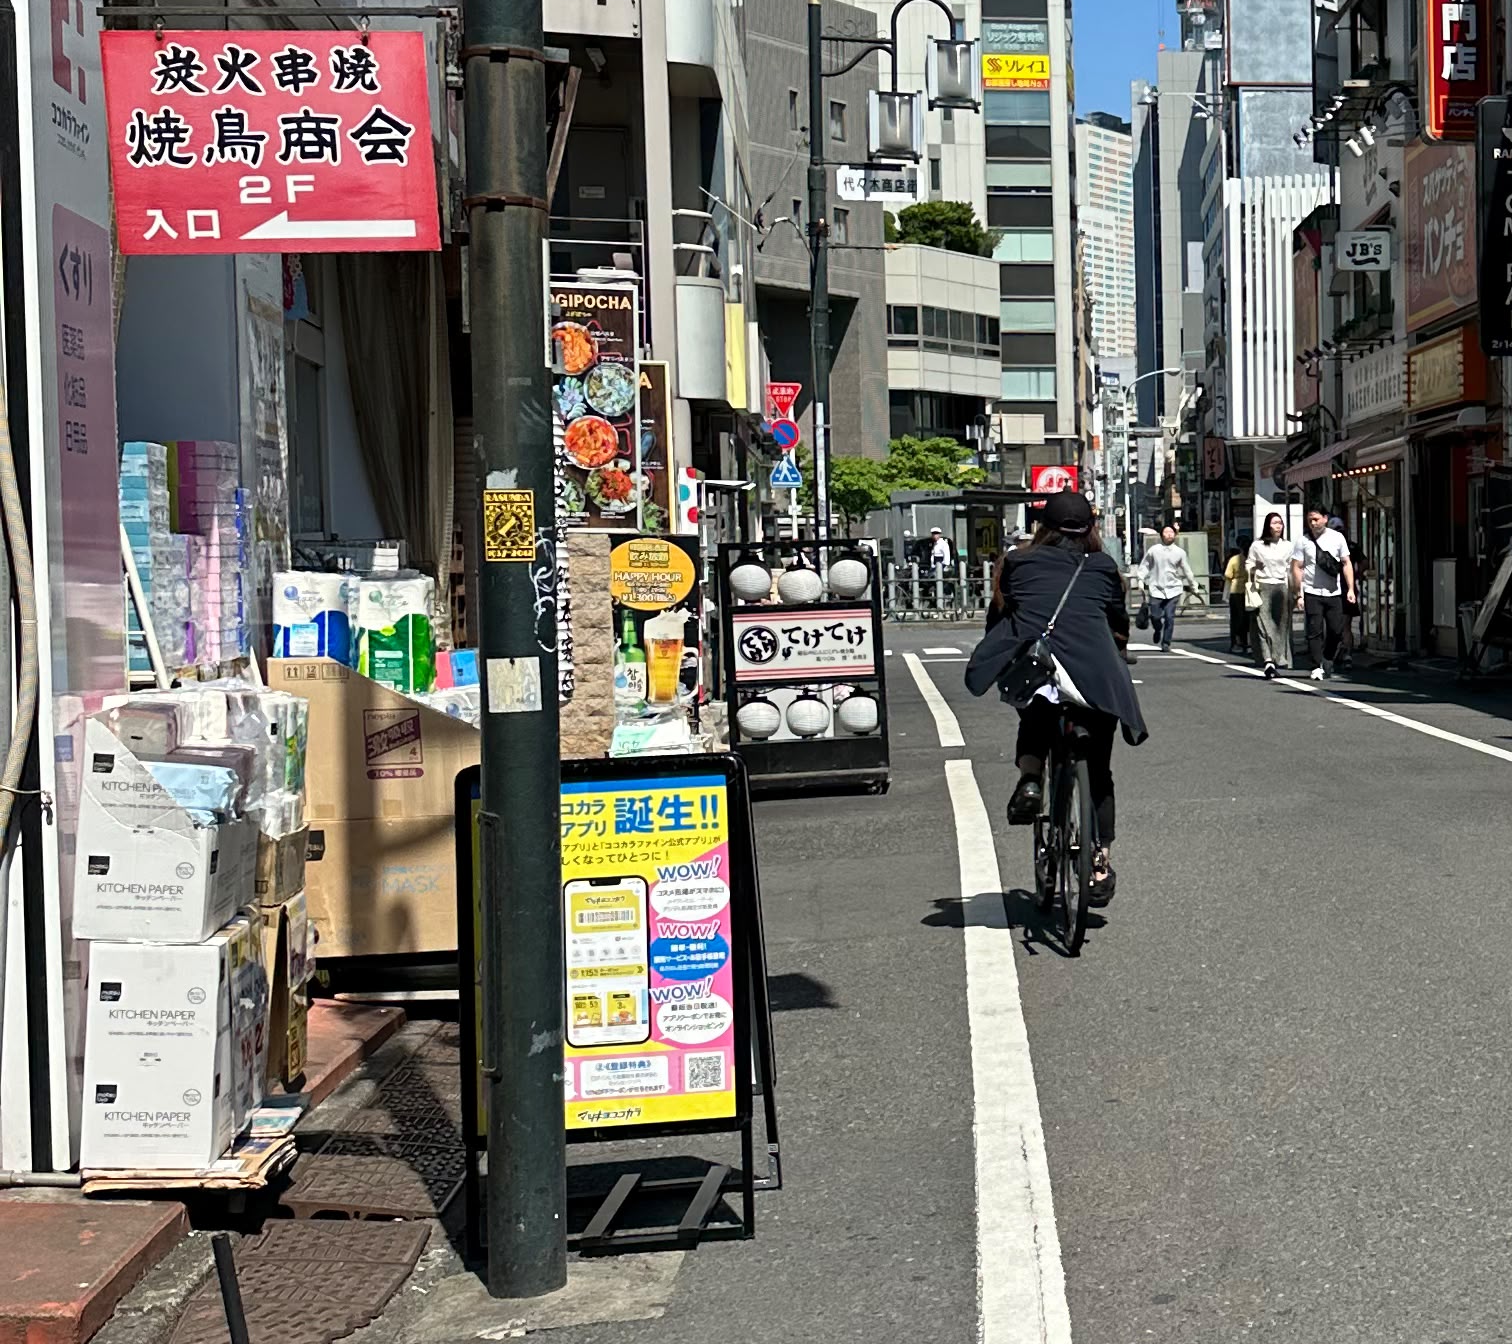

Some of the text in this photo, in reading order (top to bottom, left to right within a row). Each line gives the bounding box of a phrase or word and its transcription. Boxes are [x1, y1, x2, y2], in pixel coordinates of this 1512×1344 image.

[154, 47, 378, 93] 炭火串焼
[128, 106, 414, 164] 焼鳥商会
[238, 174, 316, 204] 2F
[143, 209, 221, 240] 入口
[1346, 242, 1382, 258] JB'S
[59, 242, 92, 306] くすり
[614, 572, 683, 582] HAPPY HOUR
[782, 622, 867, 649] てけてけ
[613, 794, 720, 835] 誕生!!
[657, 856, 719, 880] WOW!
[97, 883, 184, 895] KITCHEN PAPER
[382, 875, 442, 896] MASK
[659, 921, 720, 939] WOW!
[652, 977, 712, 1002] WOW!
[108, 1009, 196, 1020] KITCHEN PAPER
[104, 1111, 191, 1122] KITCHEN PAPER
